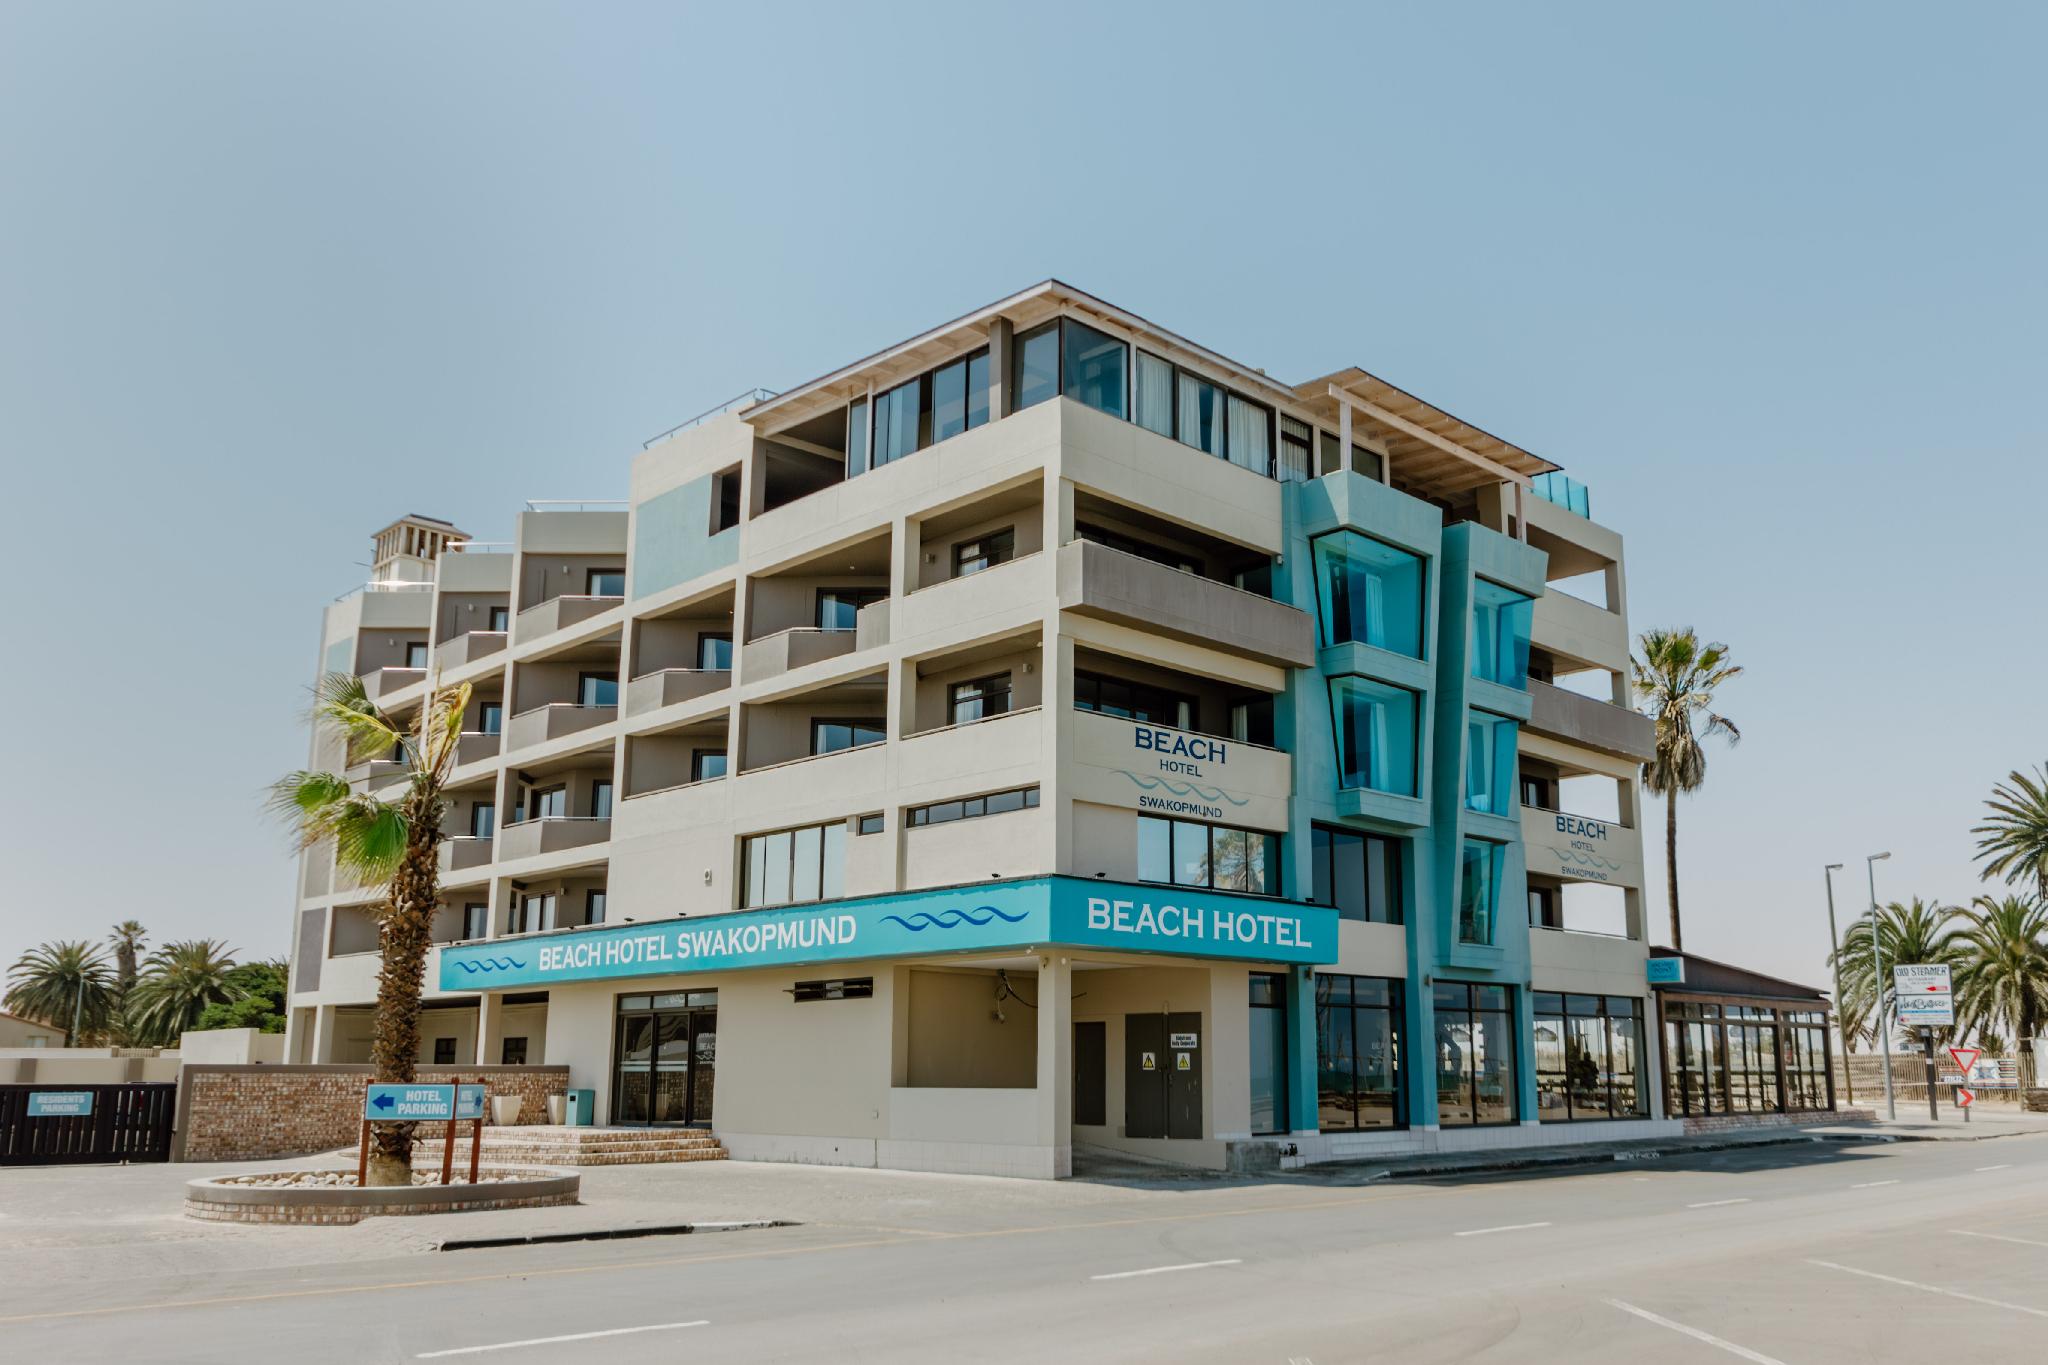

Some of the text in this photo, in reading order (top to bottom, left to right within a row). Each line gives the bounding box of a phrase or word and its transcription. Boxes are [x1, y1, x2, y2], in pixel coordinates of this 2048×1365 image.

[1135, 726, 1226, 764] BEACH
[1160, 759, 1203, 777] HOTEL
[1139, 796, 1223, 818] SWAKOPMUND
[1556, 816, 1607, 840] BEACH
[1570, 841, 1596, 852] HOTEL
[1561, 866, 1608, 880] SWAKOPMUND
[1087, 897, 1312, 948] BEACH HOTEL
[539, 915, 857, 971] BEACH HOTEL SWAKOPMUND
[1911, 966, 1948, 977] STEAMER
[406, 1090, 442, 1102] HOTEL
[41, 1104, 80, 1112] PARKING
[397, 1103, 448, 1115] PARKING
